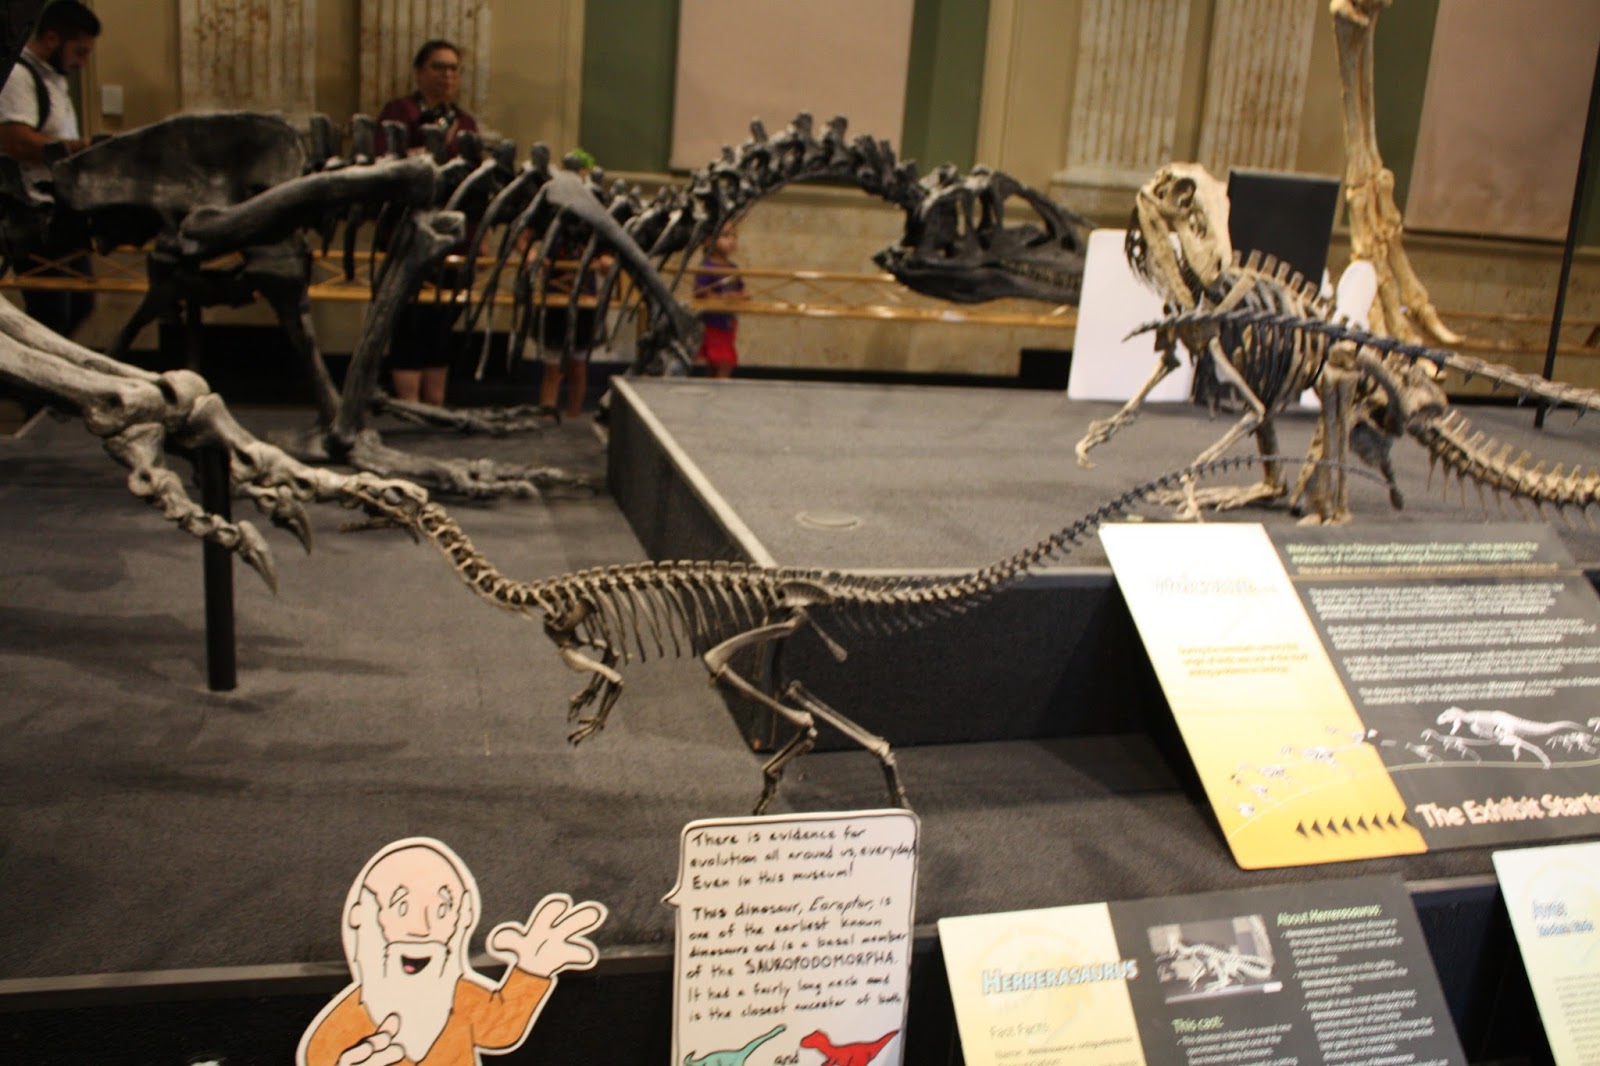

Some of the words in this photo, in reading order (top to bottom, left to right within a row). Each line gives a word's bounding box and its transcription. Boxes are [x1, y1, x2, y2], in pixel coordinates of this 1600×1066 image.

[1415, 801, 1466, 828] The
[691, 831, 739, 848] There
[747, 831, 761, 843] is
[769, 827, 836, 841] evidence
[843, 824, 867, 839] for
[690, 853, 757, 868] evolution
[764, 848, 780, 862] all
[788, 846, 833, 861] around
[691, 874, 730, 890] Even
[737, 872, 751, 887] in
[758, 869, 785, 884] this
[791, 862, 854, 881] museum!
[691, 906, 727, 921] This
[735, 901, 804, 917] dinosaur,
[879, 896, 892, 907] is
[688, 929, 709, 940] one
[718, 923, 735, 939] of
[744, 921, 765, 935] the
[774, 917, 830, 934] earliest
[840, 915, 882, 929] known
[689, 944, 749, 959] dinosaurs
[754, 940, 776, 953] and
[781, 939, 793, 951] is
[800, 941, 808, 950] a
[816, 932, 855, 948] basal
[861, 928, 909, 945] member
[686, 964, 702, 980] of
[710, 963, 735, 978] the
[982, 959, 1139, 995] HERRERASAURUS
[687, 987, 702, 1003] It
[707, 985, 730, 1000] had
[737, 989, 746, 998] a
[753, 981, 790, 1003] fairly
[798, 978, 822, 995] long
[827, 974, 859, 989] neck
[867, 972, 891, 985] and
[688, 1010, 702, 1022] is
[709, 1004, 731, 1020] the
[741, 1001, 788, 1019] closest
[795, 998, 847, 1012] ancestor
[856, 993, 871, 1006] of
[774, 1049, 800, 1065] and
